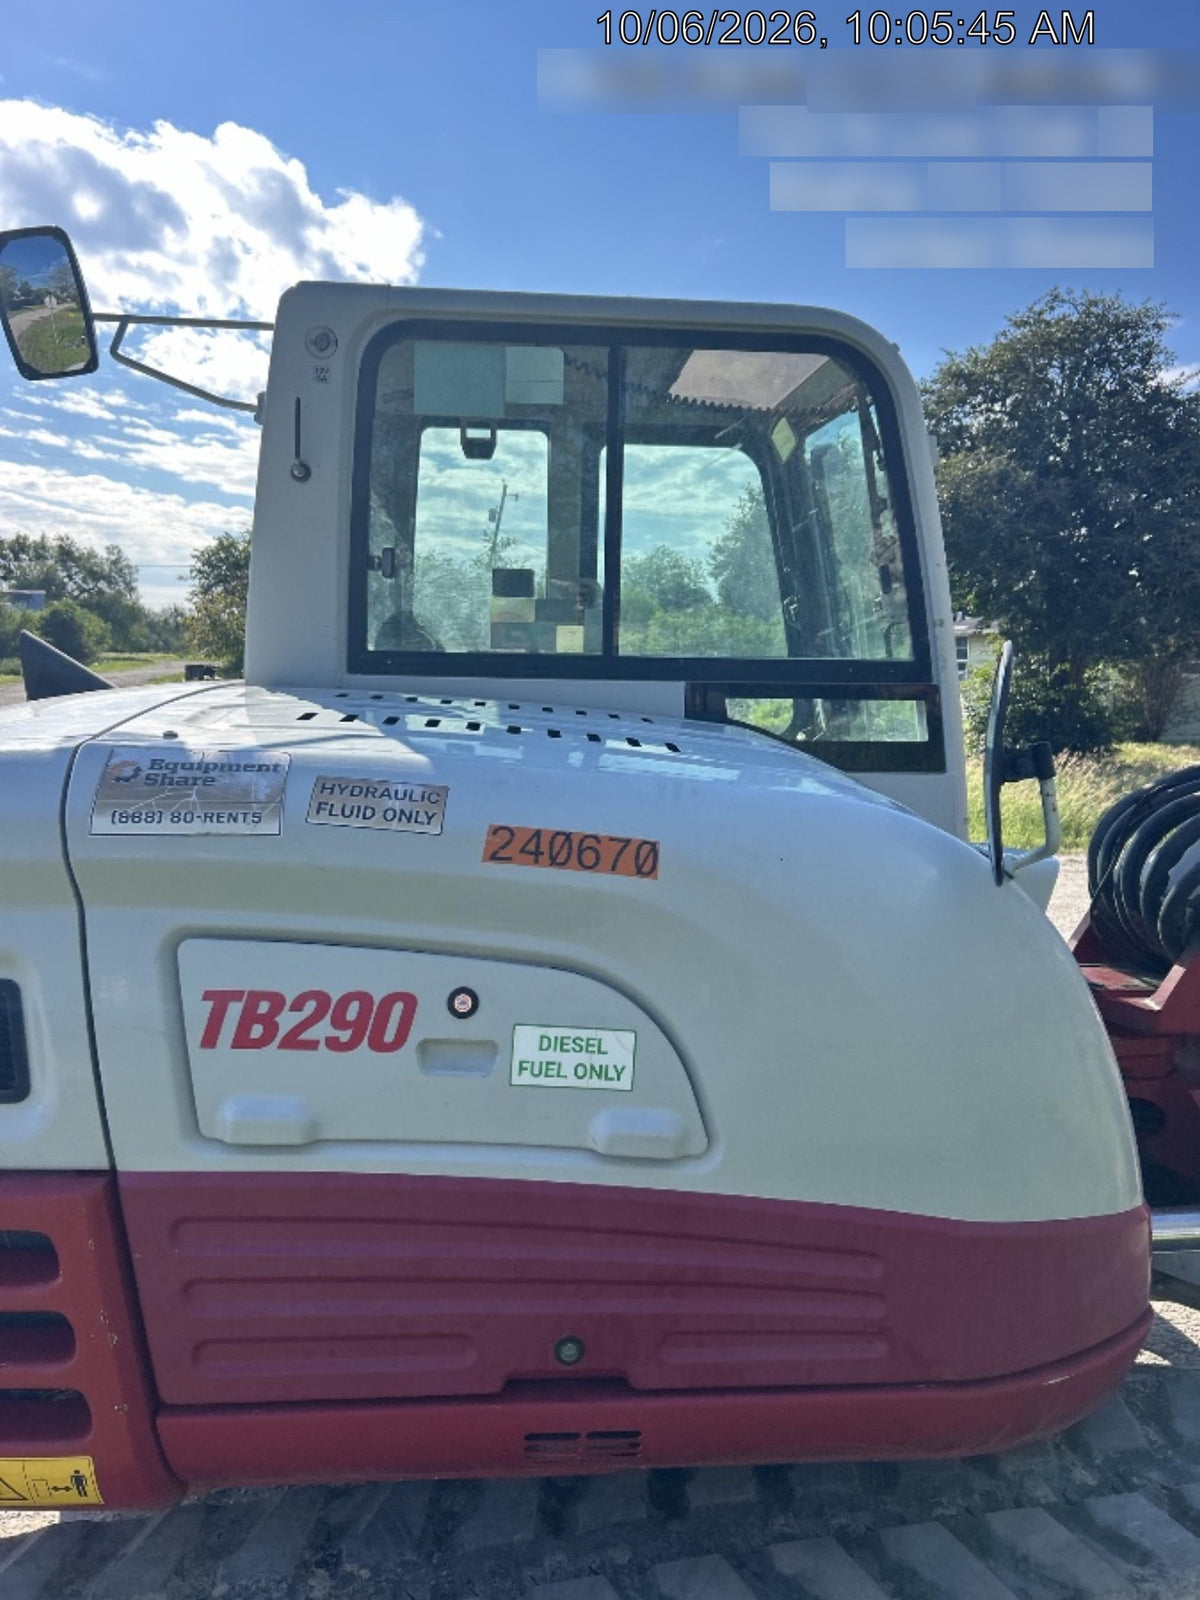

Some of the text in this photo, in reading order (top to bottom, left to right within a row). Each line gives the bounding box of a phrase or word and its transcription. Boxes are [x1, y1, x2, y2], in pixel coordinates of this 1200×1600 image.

[148, 758, 281, 773] Equipment
[143, 773, 217, 787] Share
[319, 781, 441, 804] HYDRAULIC
[111, 810, 262, 825] (888) 80-RENTS
[315, 801, 438, 826] FLUID ONLY
[488, 826, 659, 876] 240670
[200, 989, 419, 1053] TB290
[538, 1034, 609, 1055] DIESEL
[517, 1060, 627, 1082] FUEL ONLY
